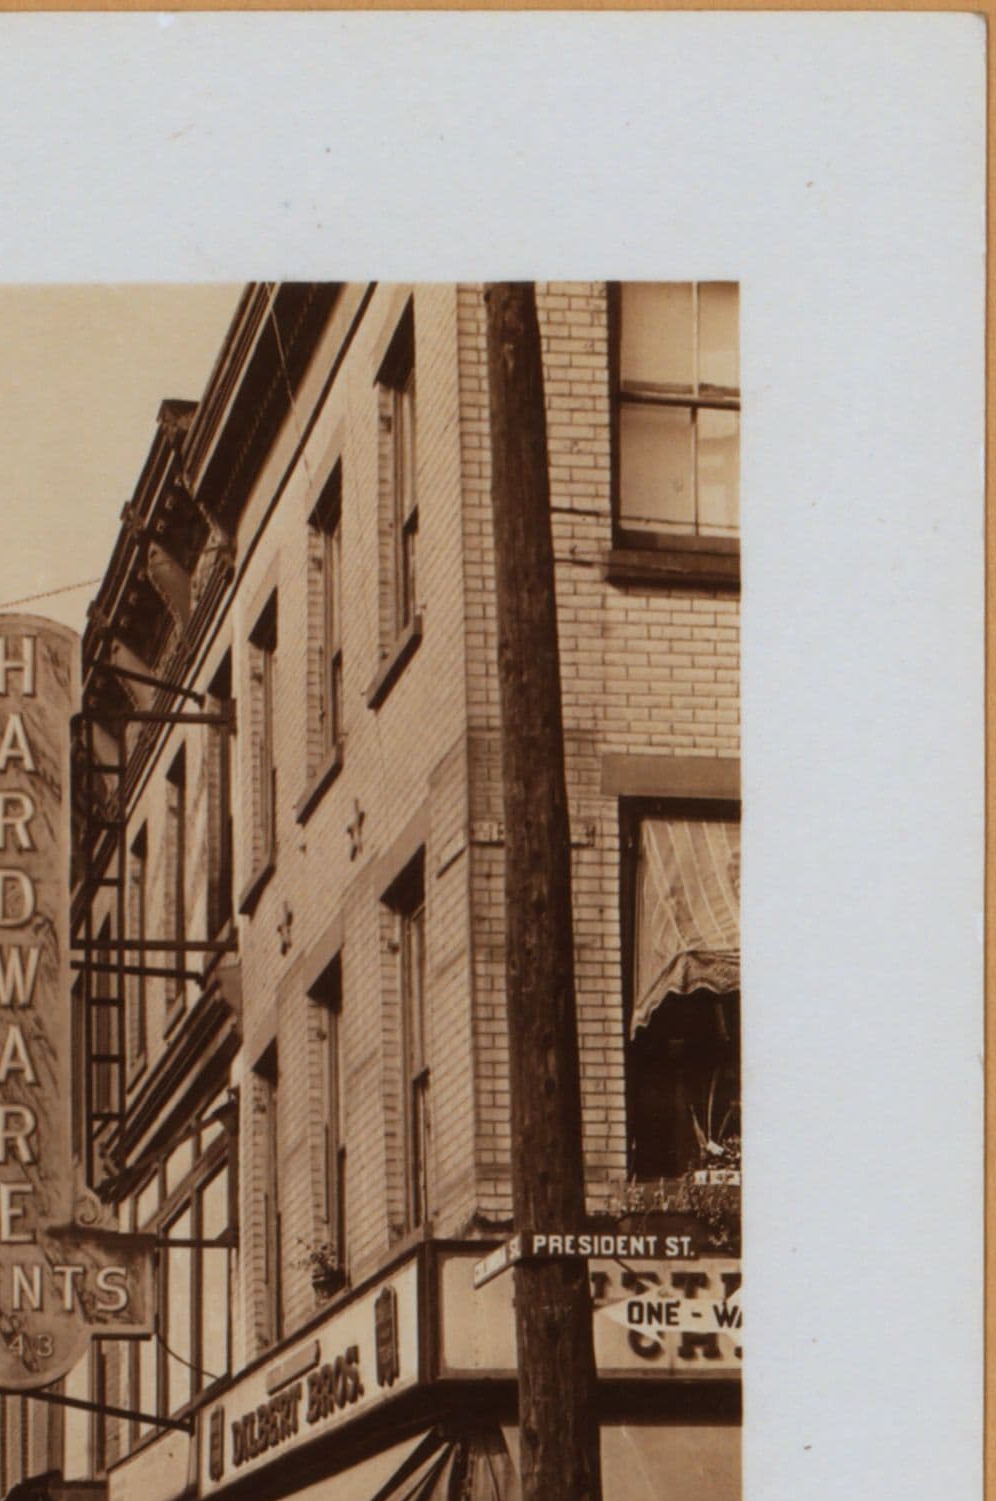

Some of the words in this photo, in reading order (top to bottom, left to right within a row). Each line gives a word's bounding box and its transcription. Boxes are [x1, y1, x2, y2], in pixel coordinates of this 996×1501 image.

[532, 1234, 658, 1257] PRESIDENT
[664, 1235, 696, 1257] ST.
[627, 1300, 680, 1326] ONE
[232, 1383, 302, 1466] DILBERT
